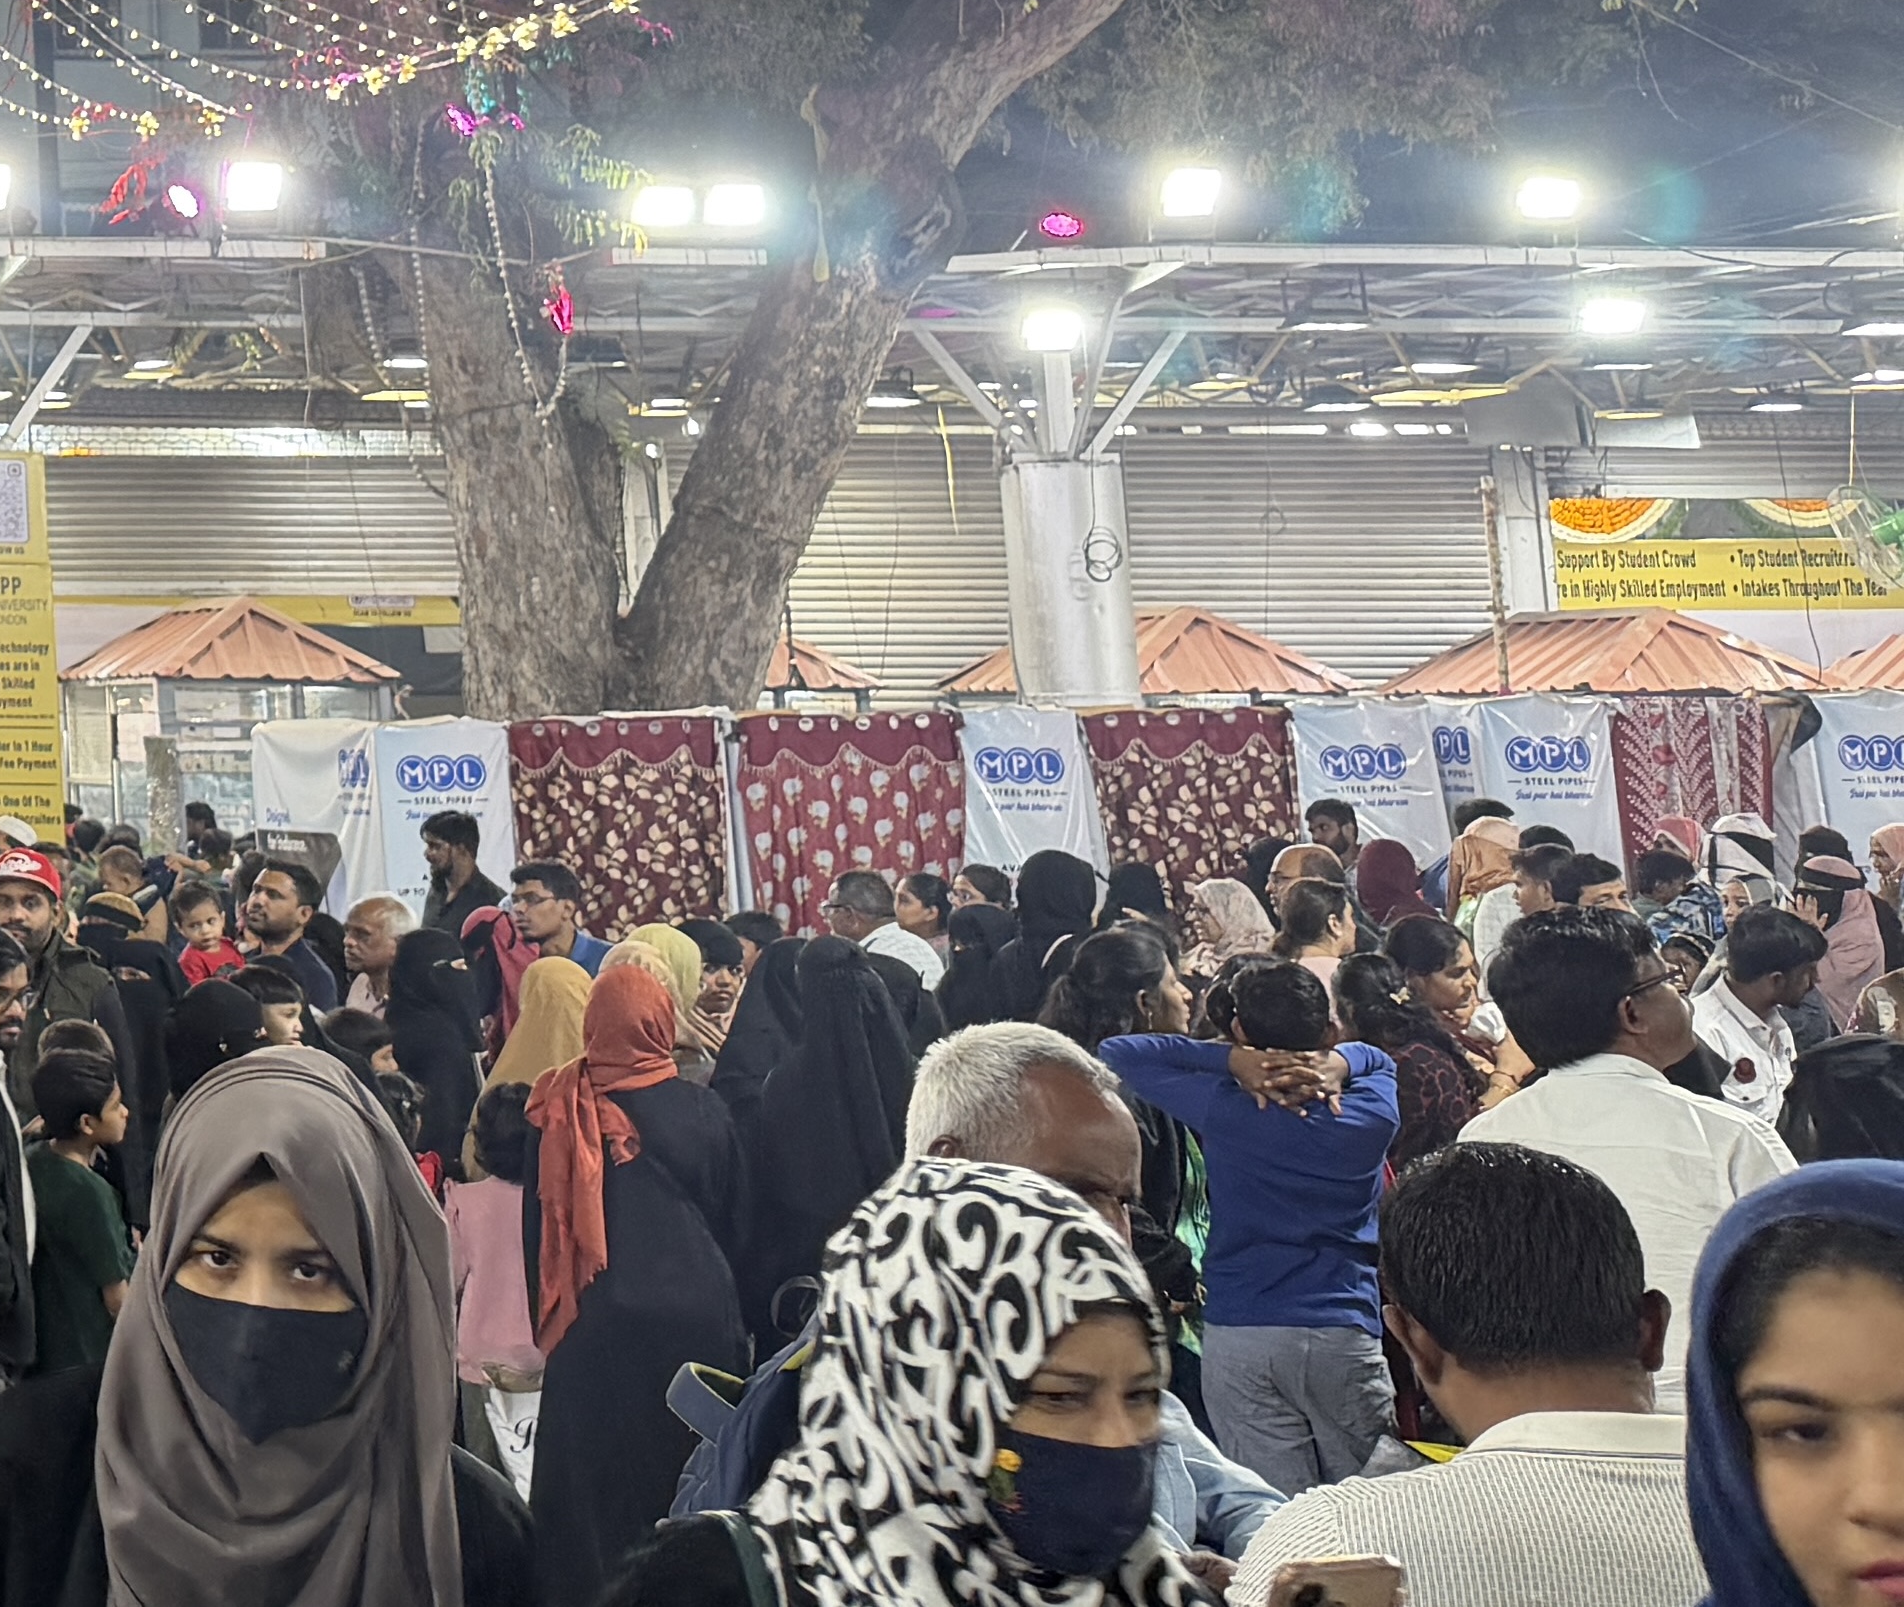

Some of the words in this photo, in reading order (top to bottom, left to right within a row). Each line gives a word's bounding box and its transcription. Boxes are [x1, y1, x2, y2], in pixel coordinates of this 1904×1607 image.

[1557, 549, 1601, 572] Support
[1602, 549, 1616, 572] By
[1618, 549, 1660, 569] Student
[1662, 548, 1697, 568] Crowd
[1582, 578, 1617, 602] Highly
[1620, 578, 1658, 599] Skilled
[1659, 578, 1727, 602] Employment
[977, 749, 1060, 781] MPL
[1509, 738, 1588, 771] MPL
[398, 757, 483, 789] MPL
